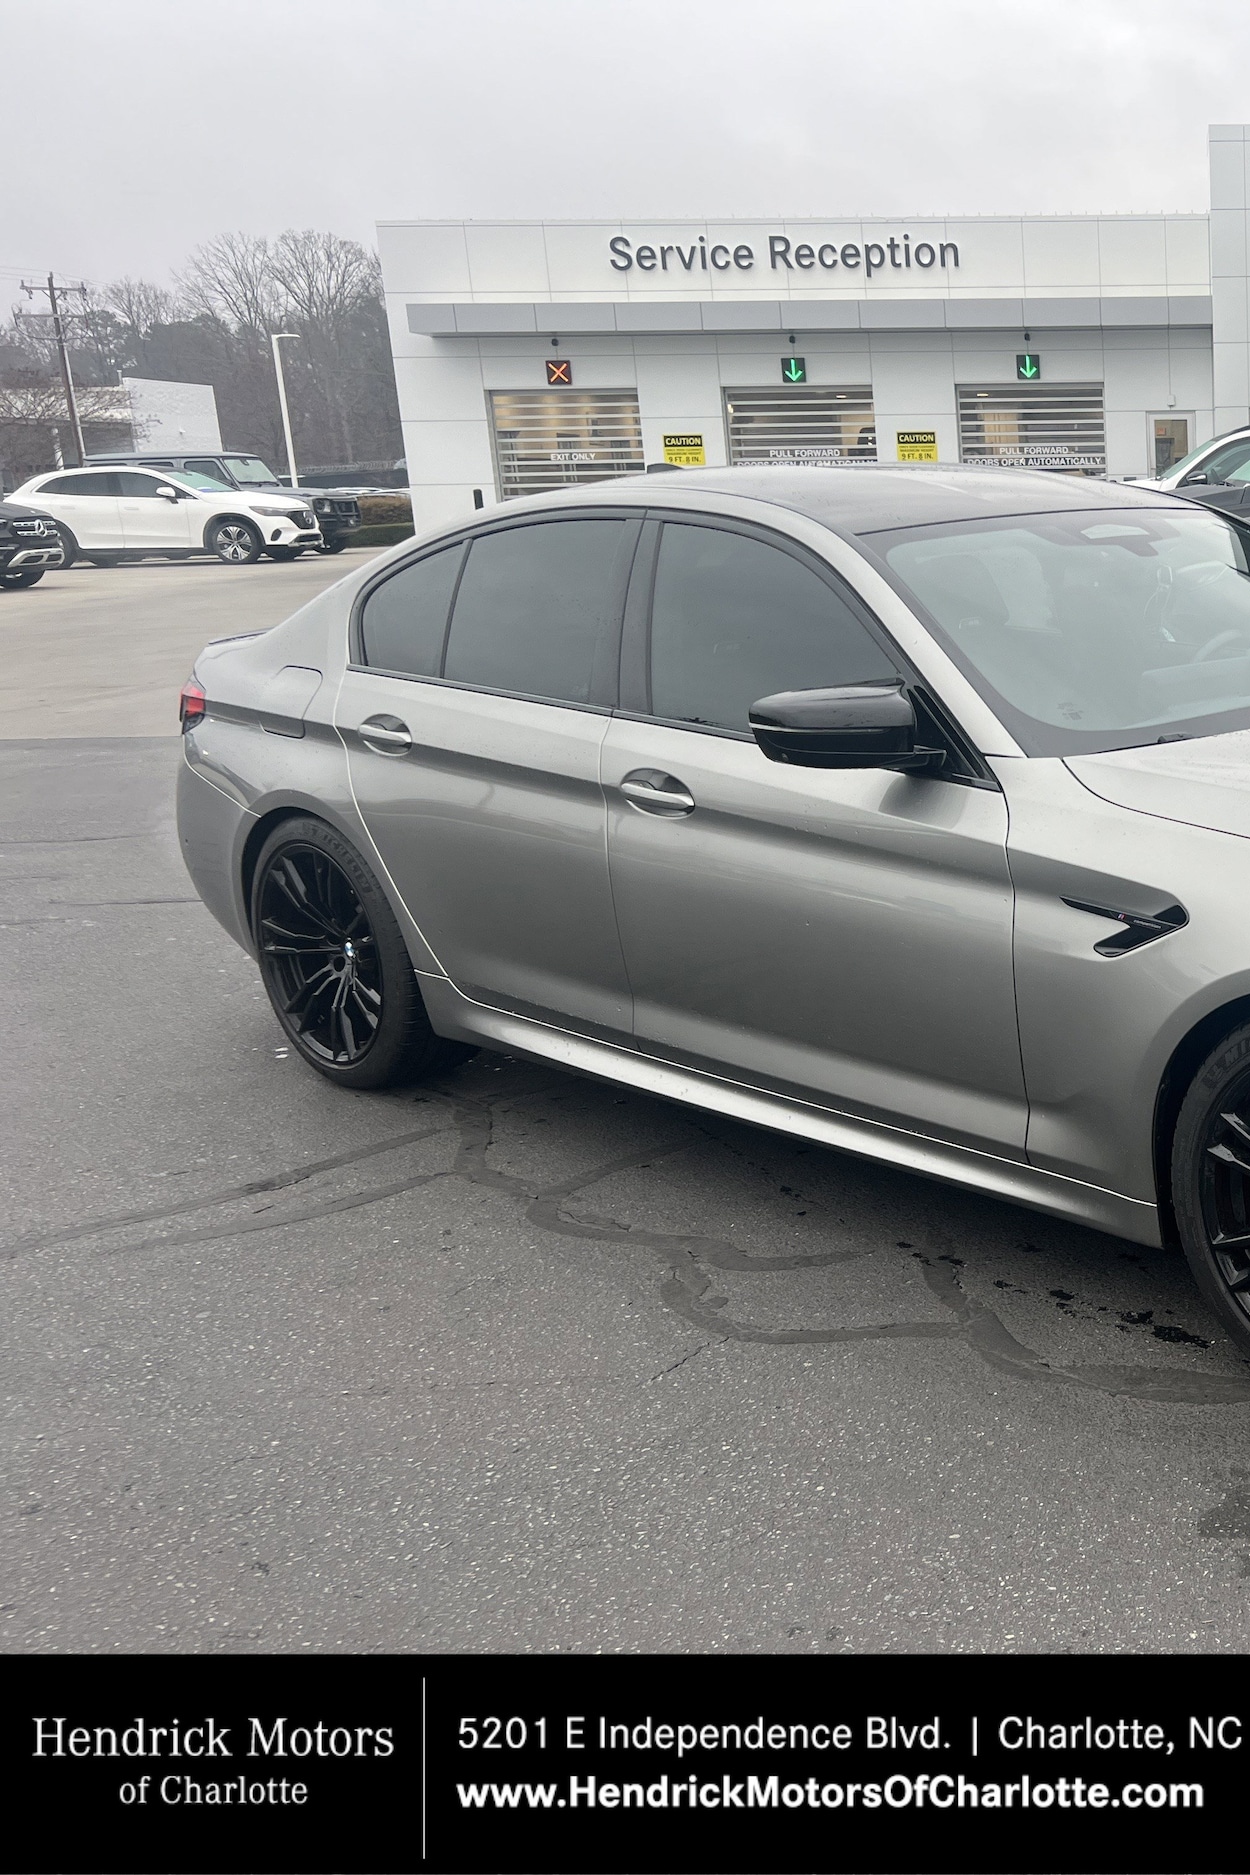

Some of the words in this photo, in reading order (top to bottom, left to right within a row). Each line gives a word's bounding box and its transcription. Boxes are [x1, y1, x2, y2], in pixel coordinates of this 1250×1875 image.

[609, 235, 754, 272] Service
[768, 233, 960, 278] Reception
[665, 437, 701, 445] CAUTION
[898, 434, 934, 442] CAUTION
[770, 449, 793, 458] PULL
[795, 448, 840, 458] FORWARD
[1000, 447, 1022, 455] PULL
[1024, 446, 1069, 455] FORWARD
[550, 453, 570, 461] EXIT
[572, 452, 596, 461] ONLY
[968, 458, 999, 466] DOORS
[1001, 457, 1025, 466] OPEN
[1028, 457, 1101, 466] AUTOMATICALLY
